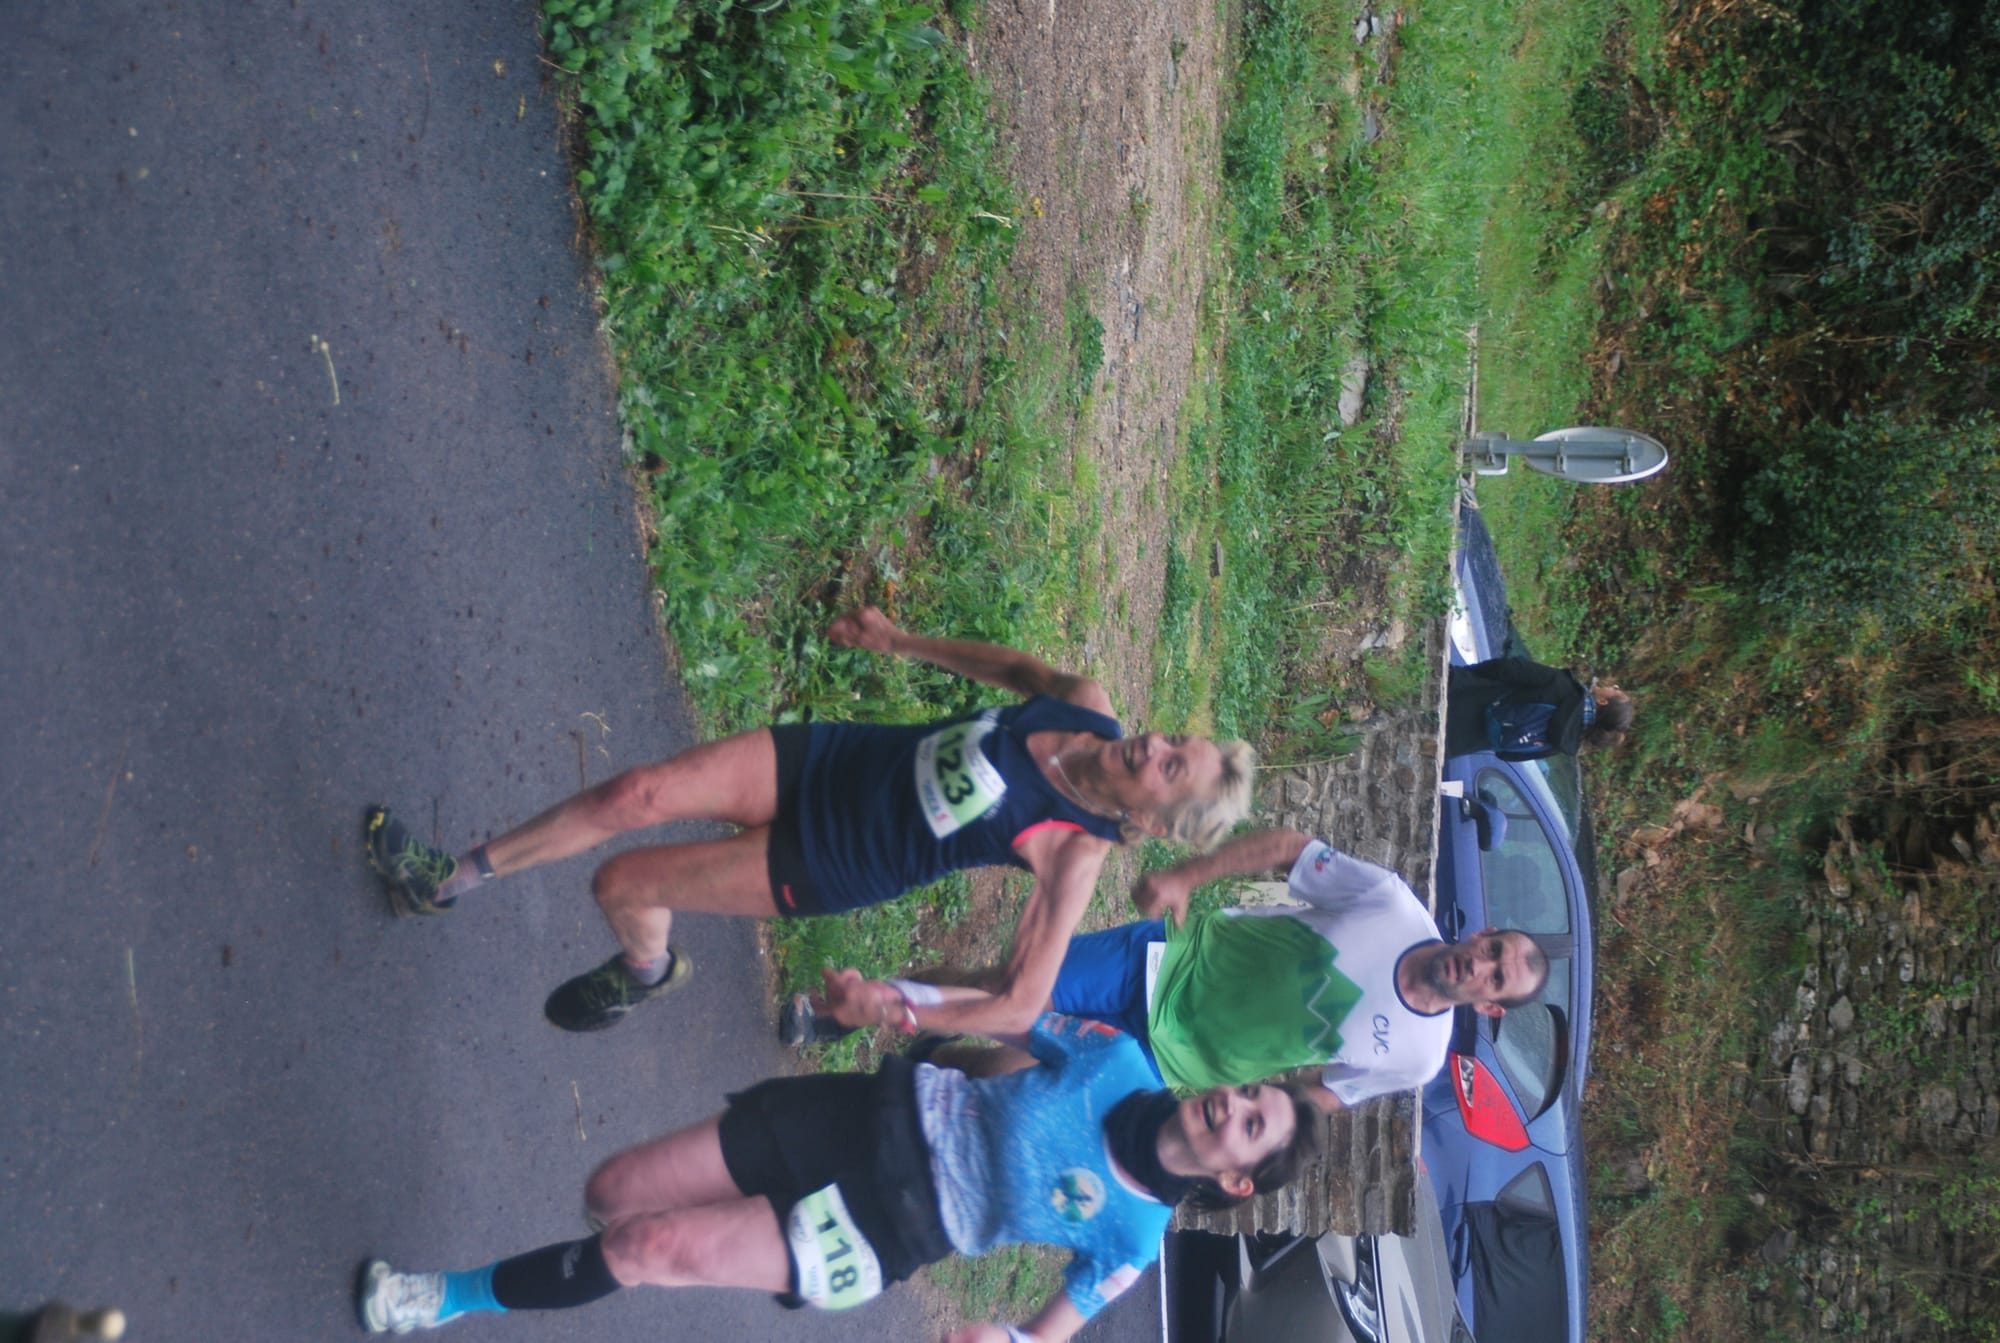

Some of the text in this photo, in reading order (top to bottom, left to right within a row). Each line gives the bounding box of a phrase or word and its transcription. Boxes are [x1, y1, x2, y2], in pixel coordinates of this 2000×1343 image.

[935, 732, 975, 805] 123
[1371, 1013, 1391, 1057] CVC
[816, 1211, 859, 1294] 118
